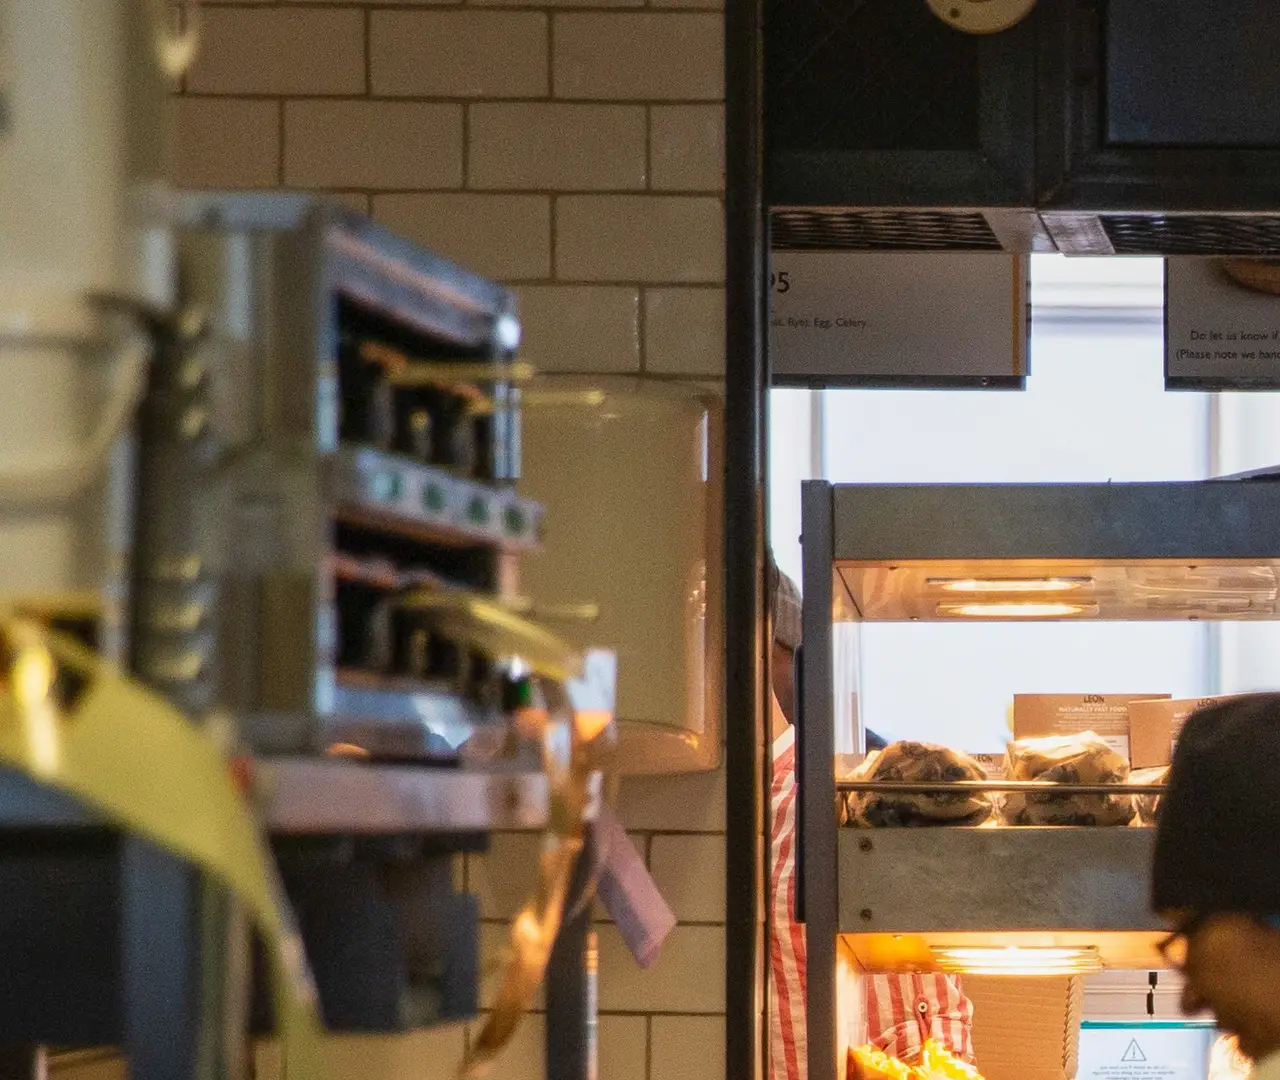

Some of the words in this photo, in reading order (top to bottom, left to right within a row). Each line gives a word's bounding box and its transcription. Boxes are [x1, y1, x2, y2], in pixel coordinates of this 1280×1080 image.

[835, 317, 867, 330] Celery
[1190, 330, 1206, 341] Do
[1209, 330, 1222, 341] let
[1226, 332, 1237, 341] us
[1241, 330, 1268, 341] know
[1272, 330, 1279, 341] if
[1176, 349, 1211, 361] (Please
[1214, 350, 1237, 360] note
[1241, 351, 1256, 360] we
[1083, 694, 1105, 704] LEON
[1058, 706, 1093, 714] NATURALLY
[1094, 706, 1108, 714] FAST
[1109, 706, 1128, 714] FOOD
